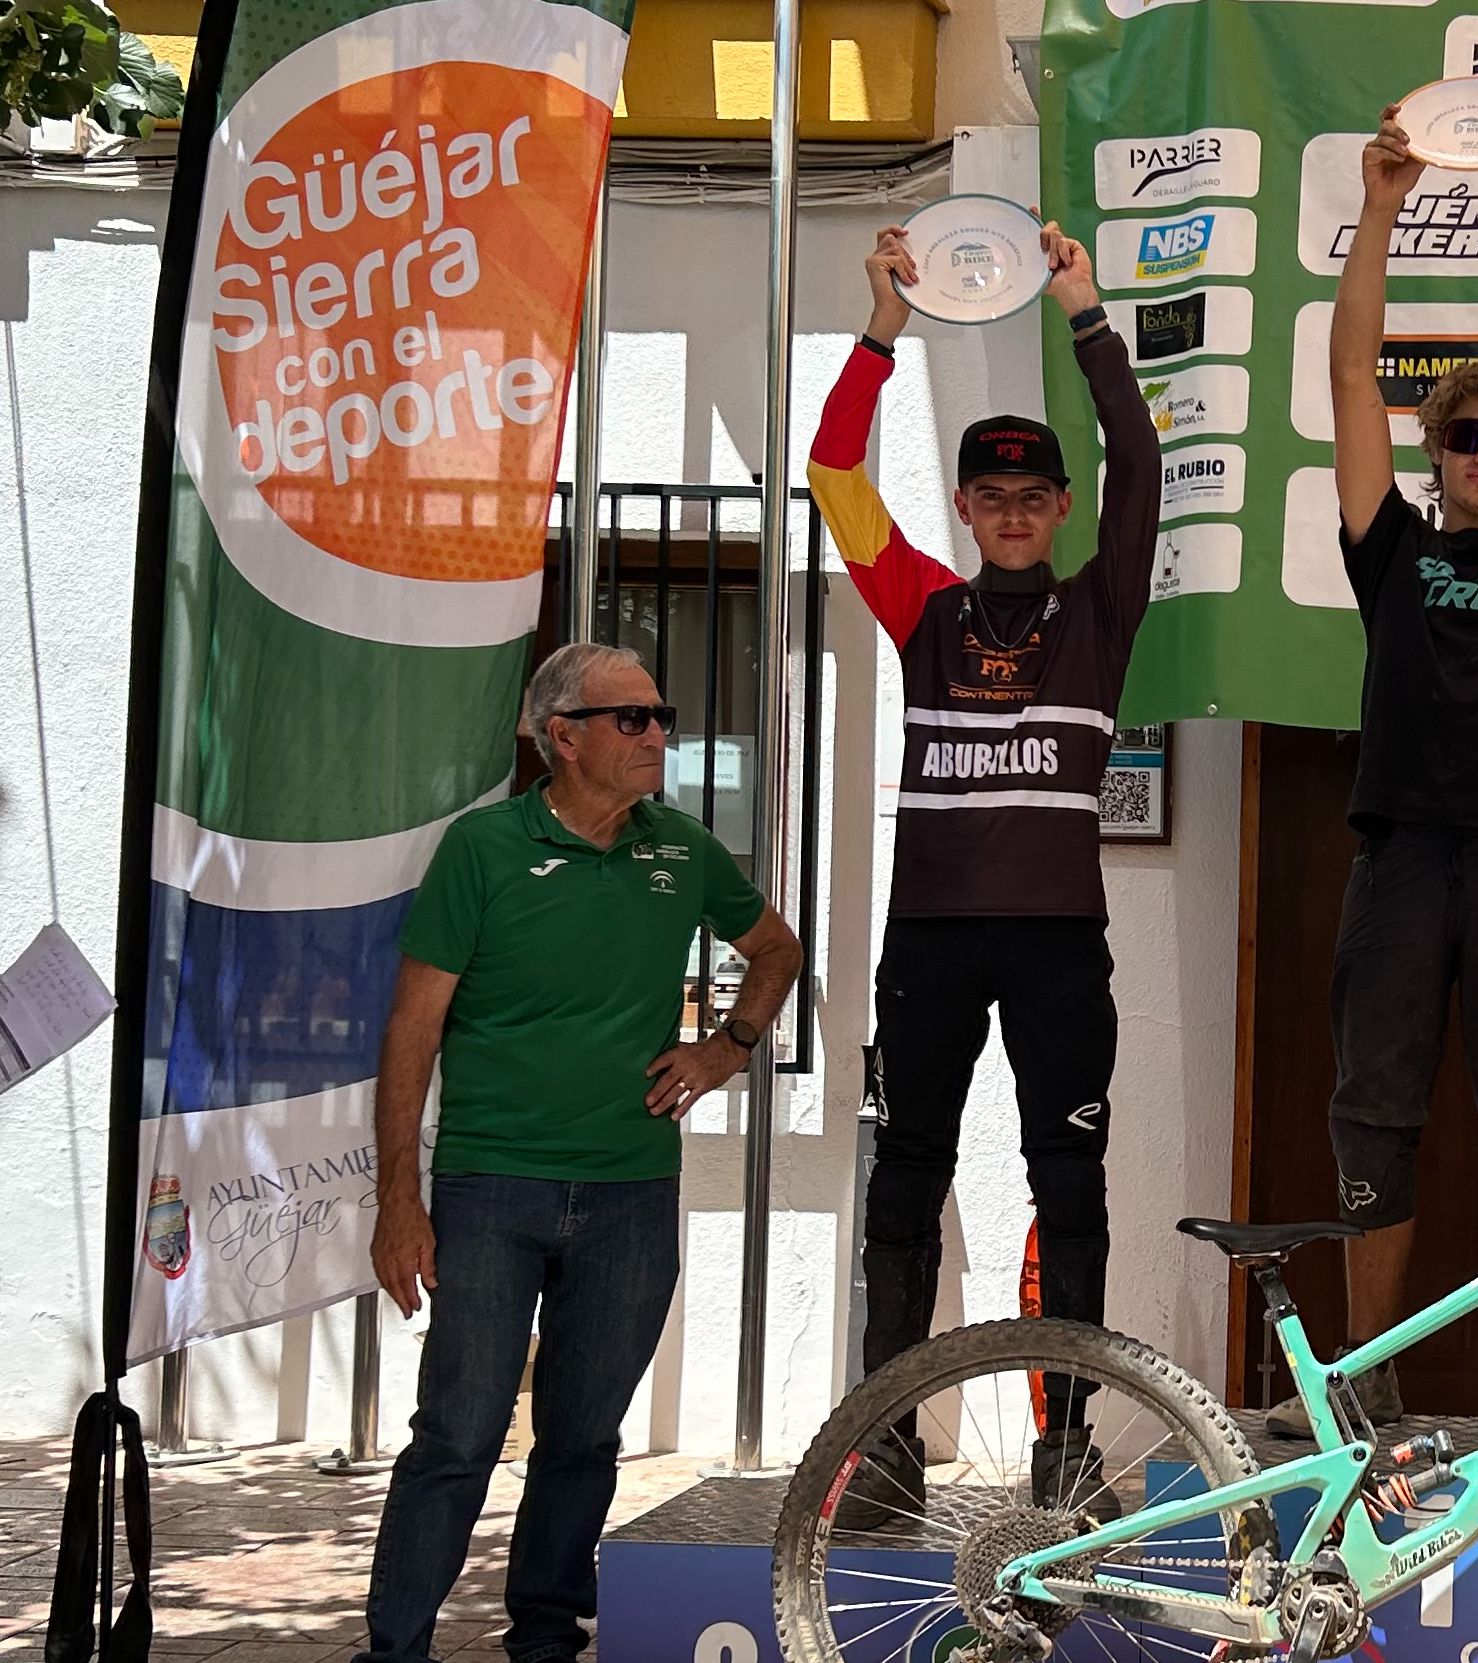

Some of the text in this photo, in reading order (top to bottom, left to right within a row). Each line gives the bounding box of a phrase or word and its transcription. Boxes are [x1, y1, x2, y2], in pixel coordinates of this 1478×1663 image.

[231, 116, 531, 249] Güéjar
[1130, 138, 1222, 168] PARRIER
[1147, 219, 1206, 258] NBS
[212, 227, 481, 353] Sierra
[275, 311, 442, 396] con el
[231, 349, 556, 486] deporte
[1164, 459, 1226, 485] EL RUBIO
